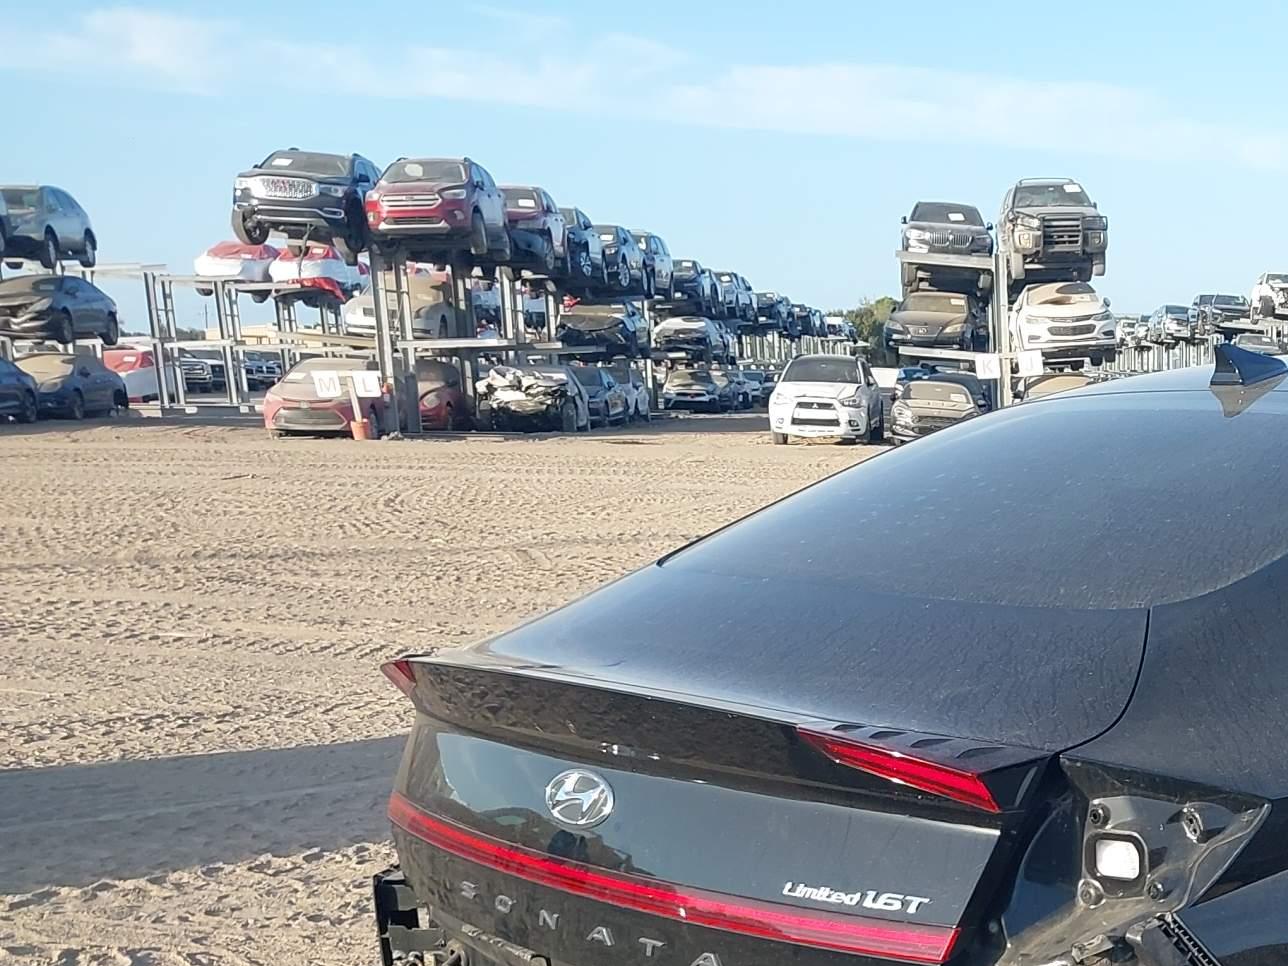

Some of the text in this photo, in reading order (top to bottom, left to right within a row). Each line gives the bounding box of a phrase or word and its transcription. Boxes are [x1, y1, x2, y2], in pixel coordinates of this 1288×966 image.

[983, 360, 993, 374] K
[319, 377, 337, 393] M
[364, 377, 374, 392] L
[782, 882, 861, 906] Limited
